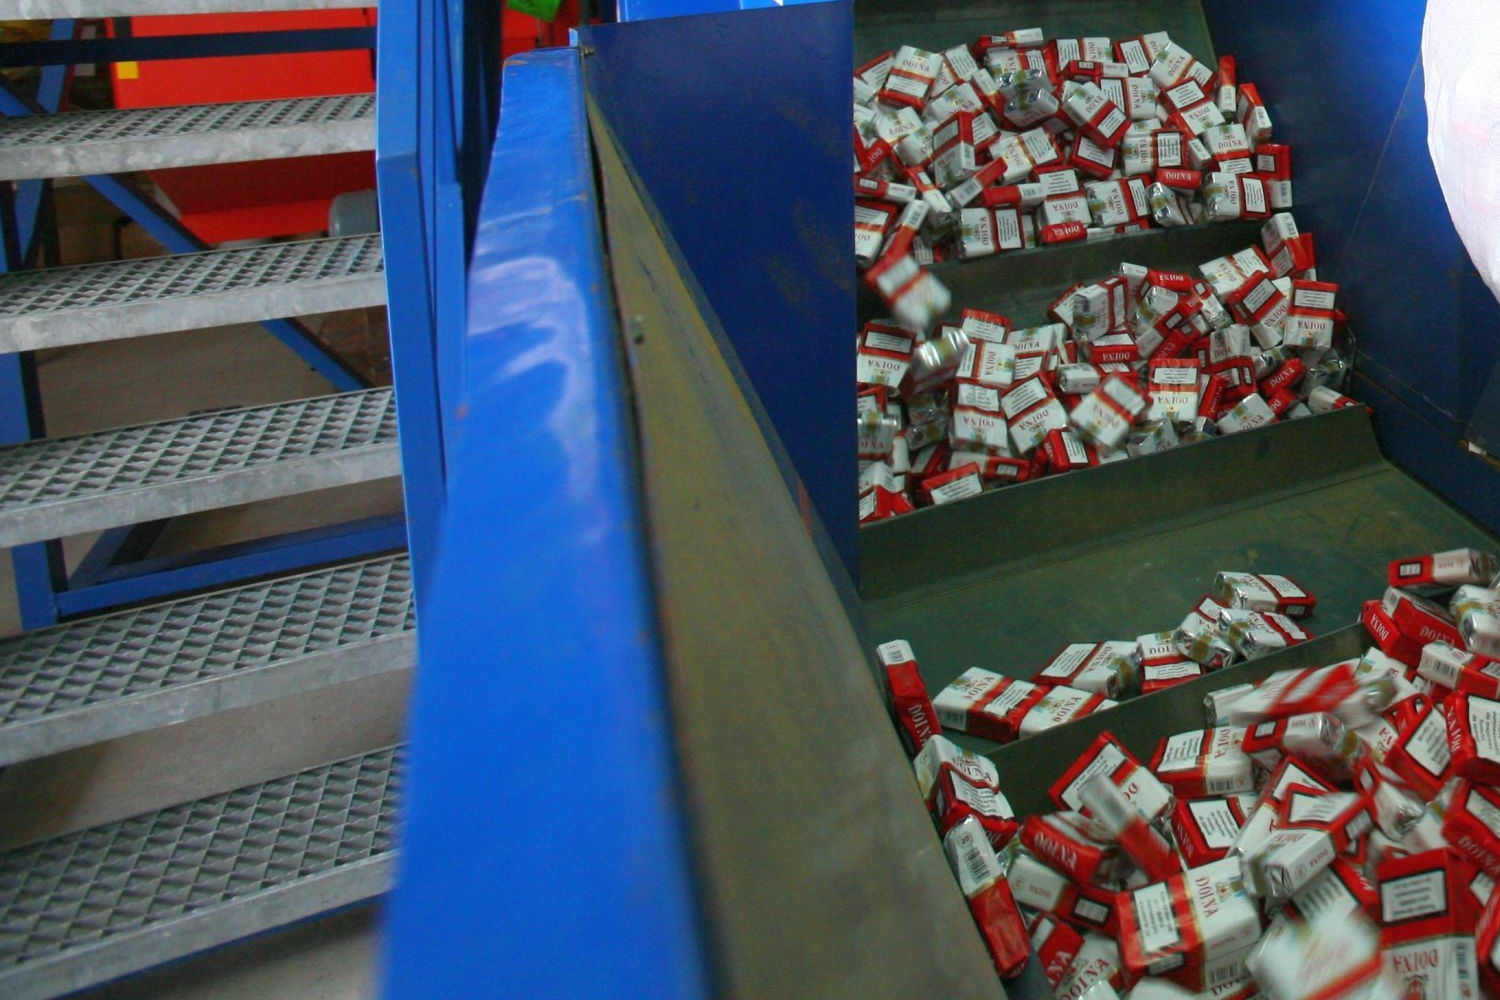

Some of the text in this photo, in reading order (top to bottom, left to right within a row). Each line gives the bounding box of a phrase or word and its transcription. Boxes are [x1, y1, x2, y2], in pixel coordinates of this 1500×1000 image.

[901, 59, 931, 74] DOINA
[1168, 55, 1187, 77] DOINA
[1132, 83, 1140, 110] DOINA
[1139, 137, 1149, 164] DOINA
[1218, 138, 1243, 151] DOINA
[1165, 172, 1192, 181] DOINA
[1112, 186, 1123, 215] DOINA
[1228, 179, 1236, 206] DOINA
[1052, 201, 1079, 212] DOINA
[979, 216, 989, 246] DOINA
[1053, 223, 1081, 236] DOINA
[1159, 273, 1185, 283] DOINA
[1264, 303, 1288, 327] DOINA
[1296, 320, 1326, 330] DOINA
[867, 359, 901, 371] DOINA
[984, 350, 995, 376] DOINA
[1102, 350, 1130, 361] DOINA
[1269, 366, 1296, 388] DOINA
[1157, 395, 1189, 405] DOINA
[962, 416, 995, 428] DOINA
[1018, 409, 1050, 430] DOINA
[1370, 614, 1390, 642] DOINA
[1084, 645, 1113, 674] DOINA
[963, 675, 995, 701] DOINA
[1052, 695, 1082, 723] DOINA
[1034, 831, 1078, 871] DOINA
[1194, 874, 1220, 919] DOINA
[1393, 948, 1440, 973] DOINA
